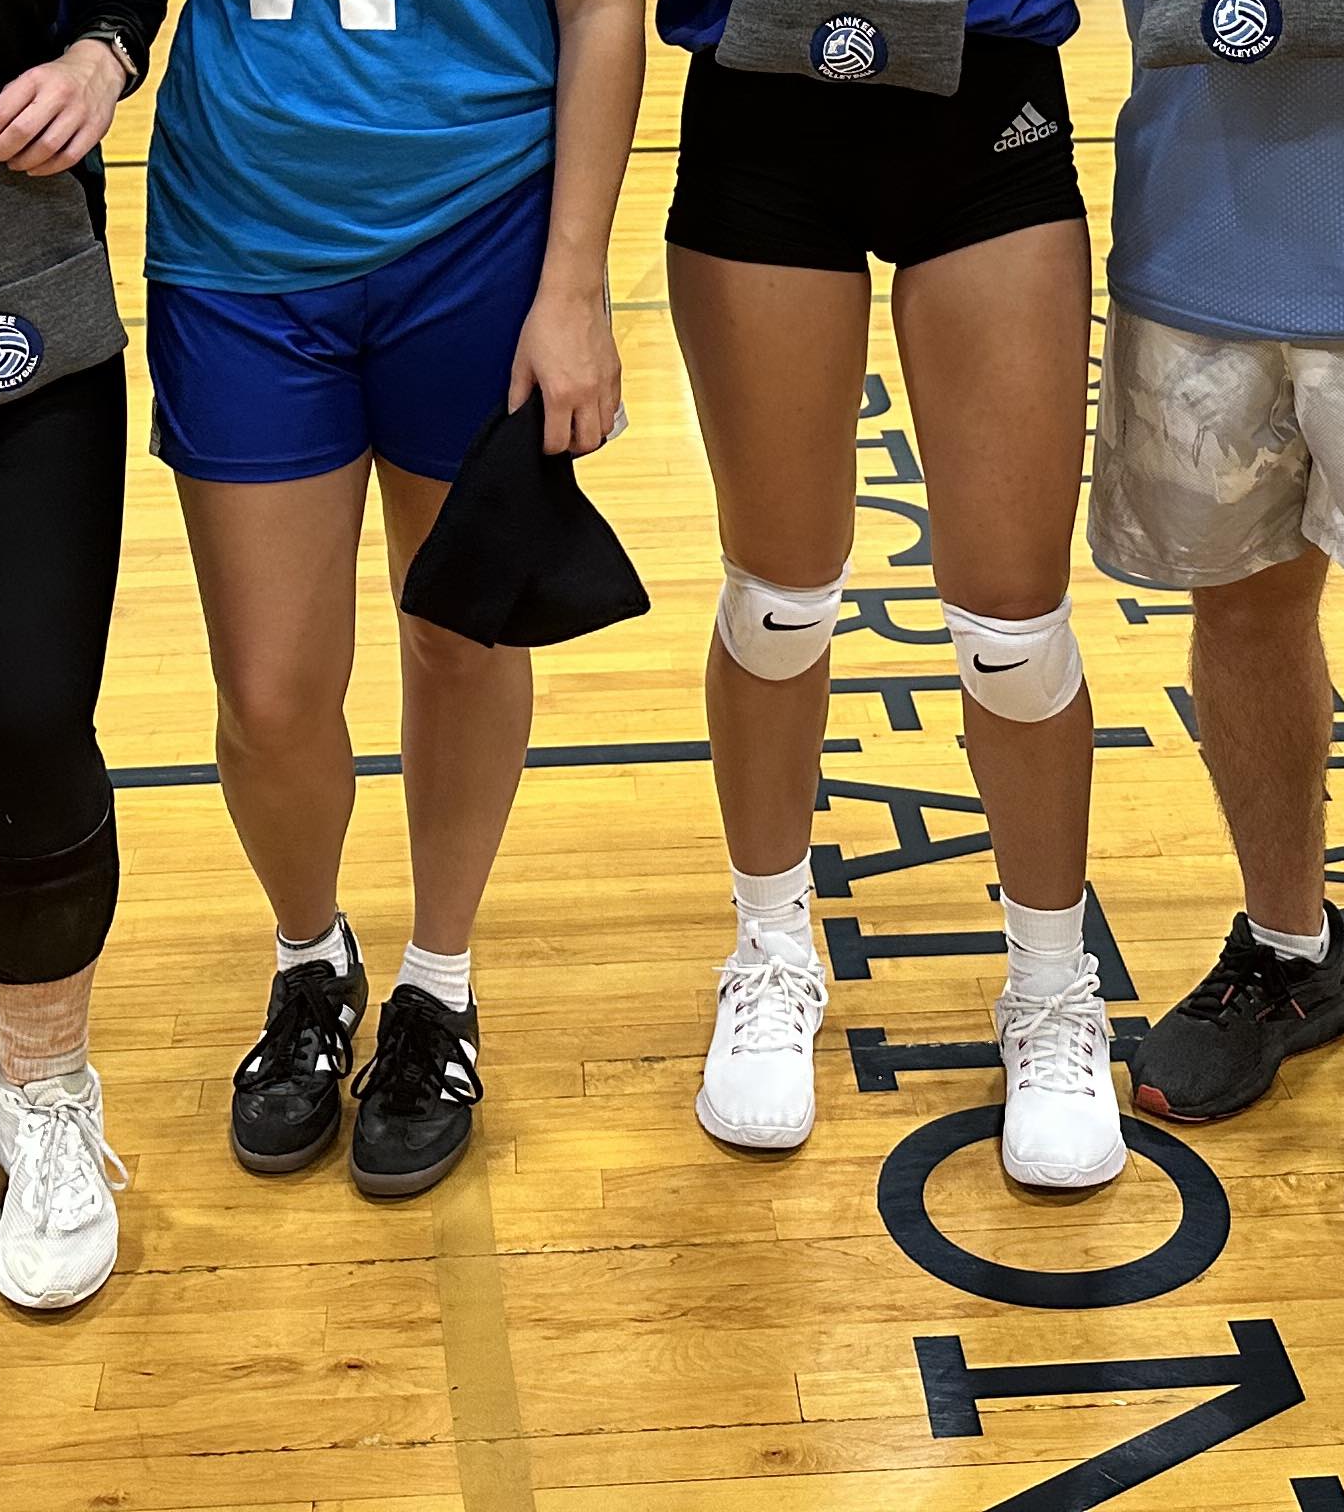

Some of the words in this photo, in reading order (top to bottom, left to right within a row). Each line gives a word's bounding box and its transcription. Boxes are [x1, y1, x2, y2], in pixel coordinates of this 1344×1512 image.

[824, 16, 876, 38] YANKEE
[1212, 35, 1274, 58] VOLLEYBALL
[818, 63, 876, 80] VOLLEYBALL
[994, 121, 1058, 153] adidas
